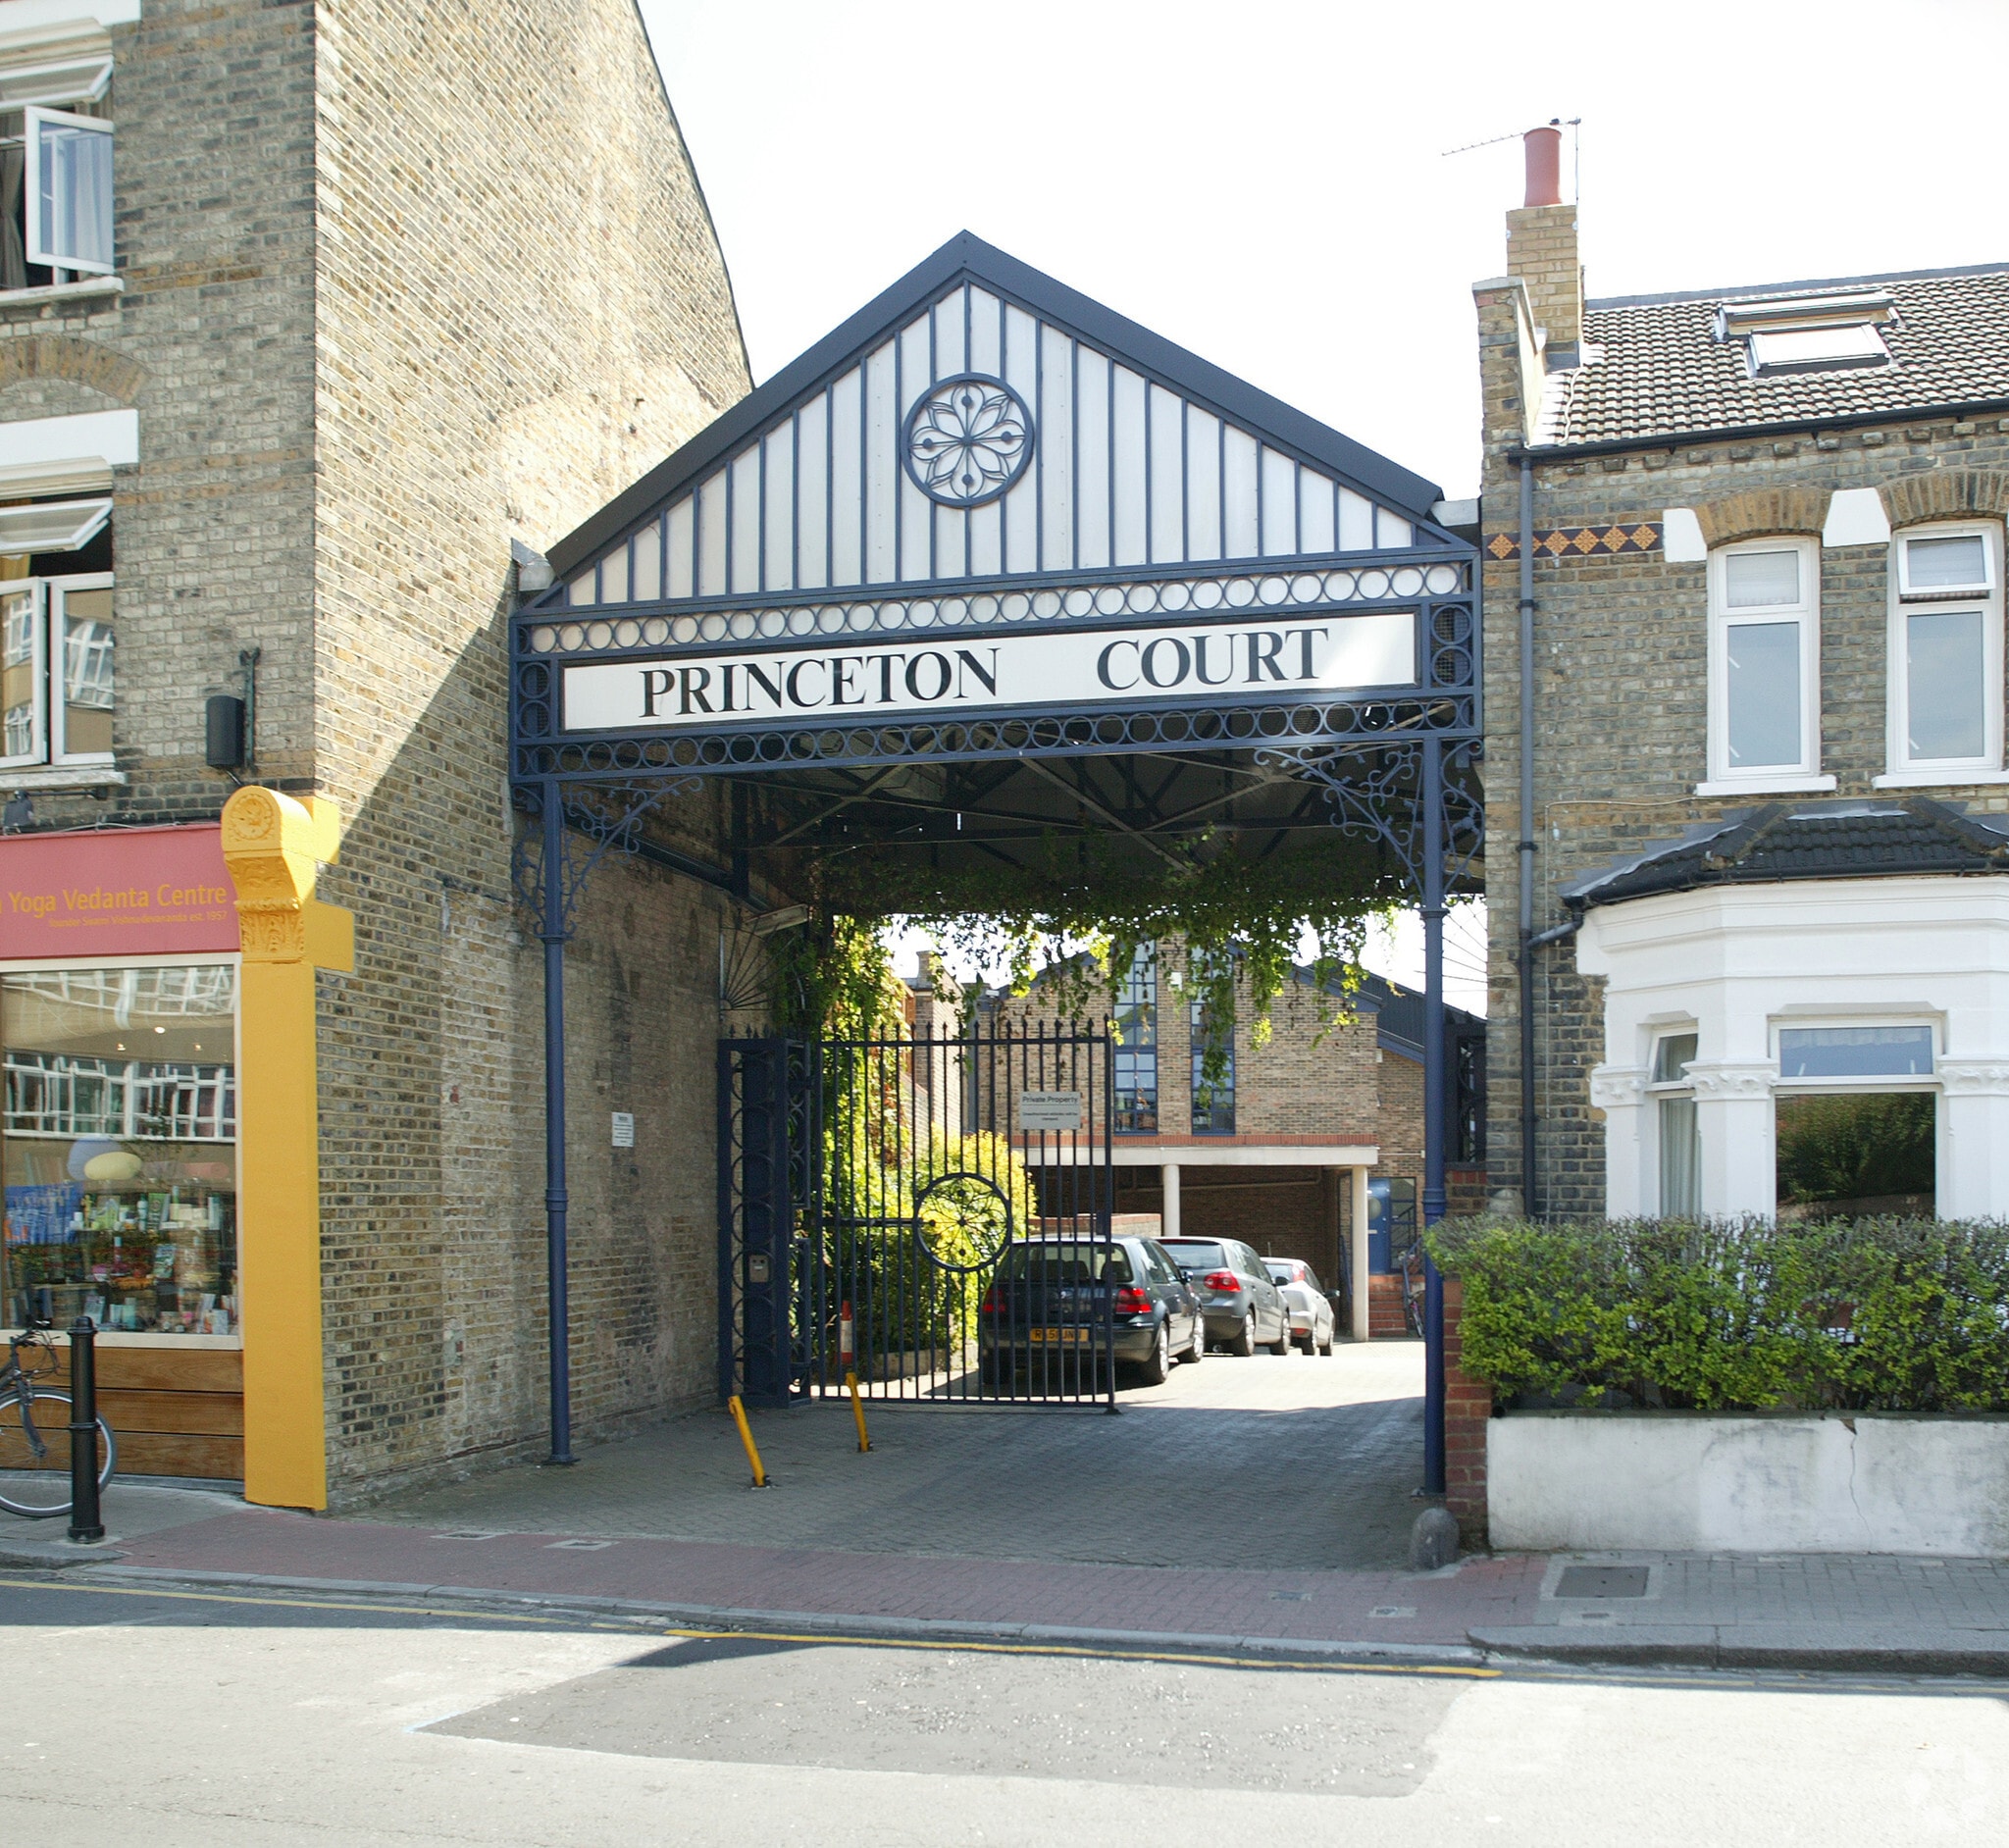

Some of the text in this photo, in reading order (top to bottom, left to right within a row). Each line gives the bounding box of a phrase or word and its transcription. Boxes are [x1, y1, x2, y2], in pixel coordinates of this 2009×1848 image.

[638, 628, 1329, 718] PRINCETON COURT
[8, 891, 57, 919] Yoga
[62, 886, 149, 911] Vedanta
[157, 884, 228, 906] Centre
[1048, 1096, 1078, 1104] Property
